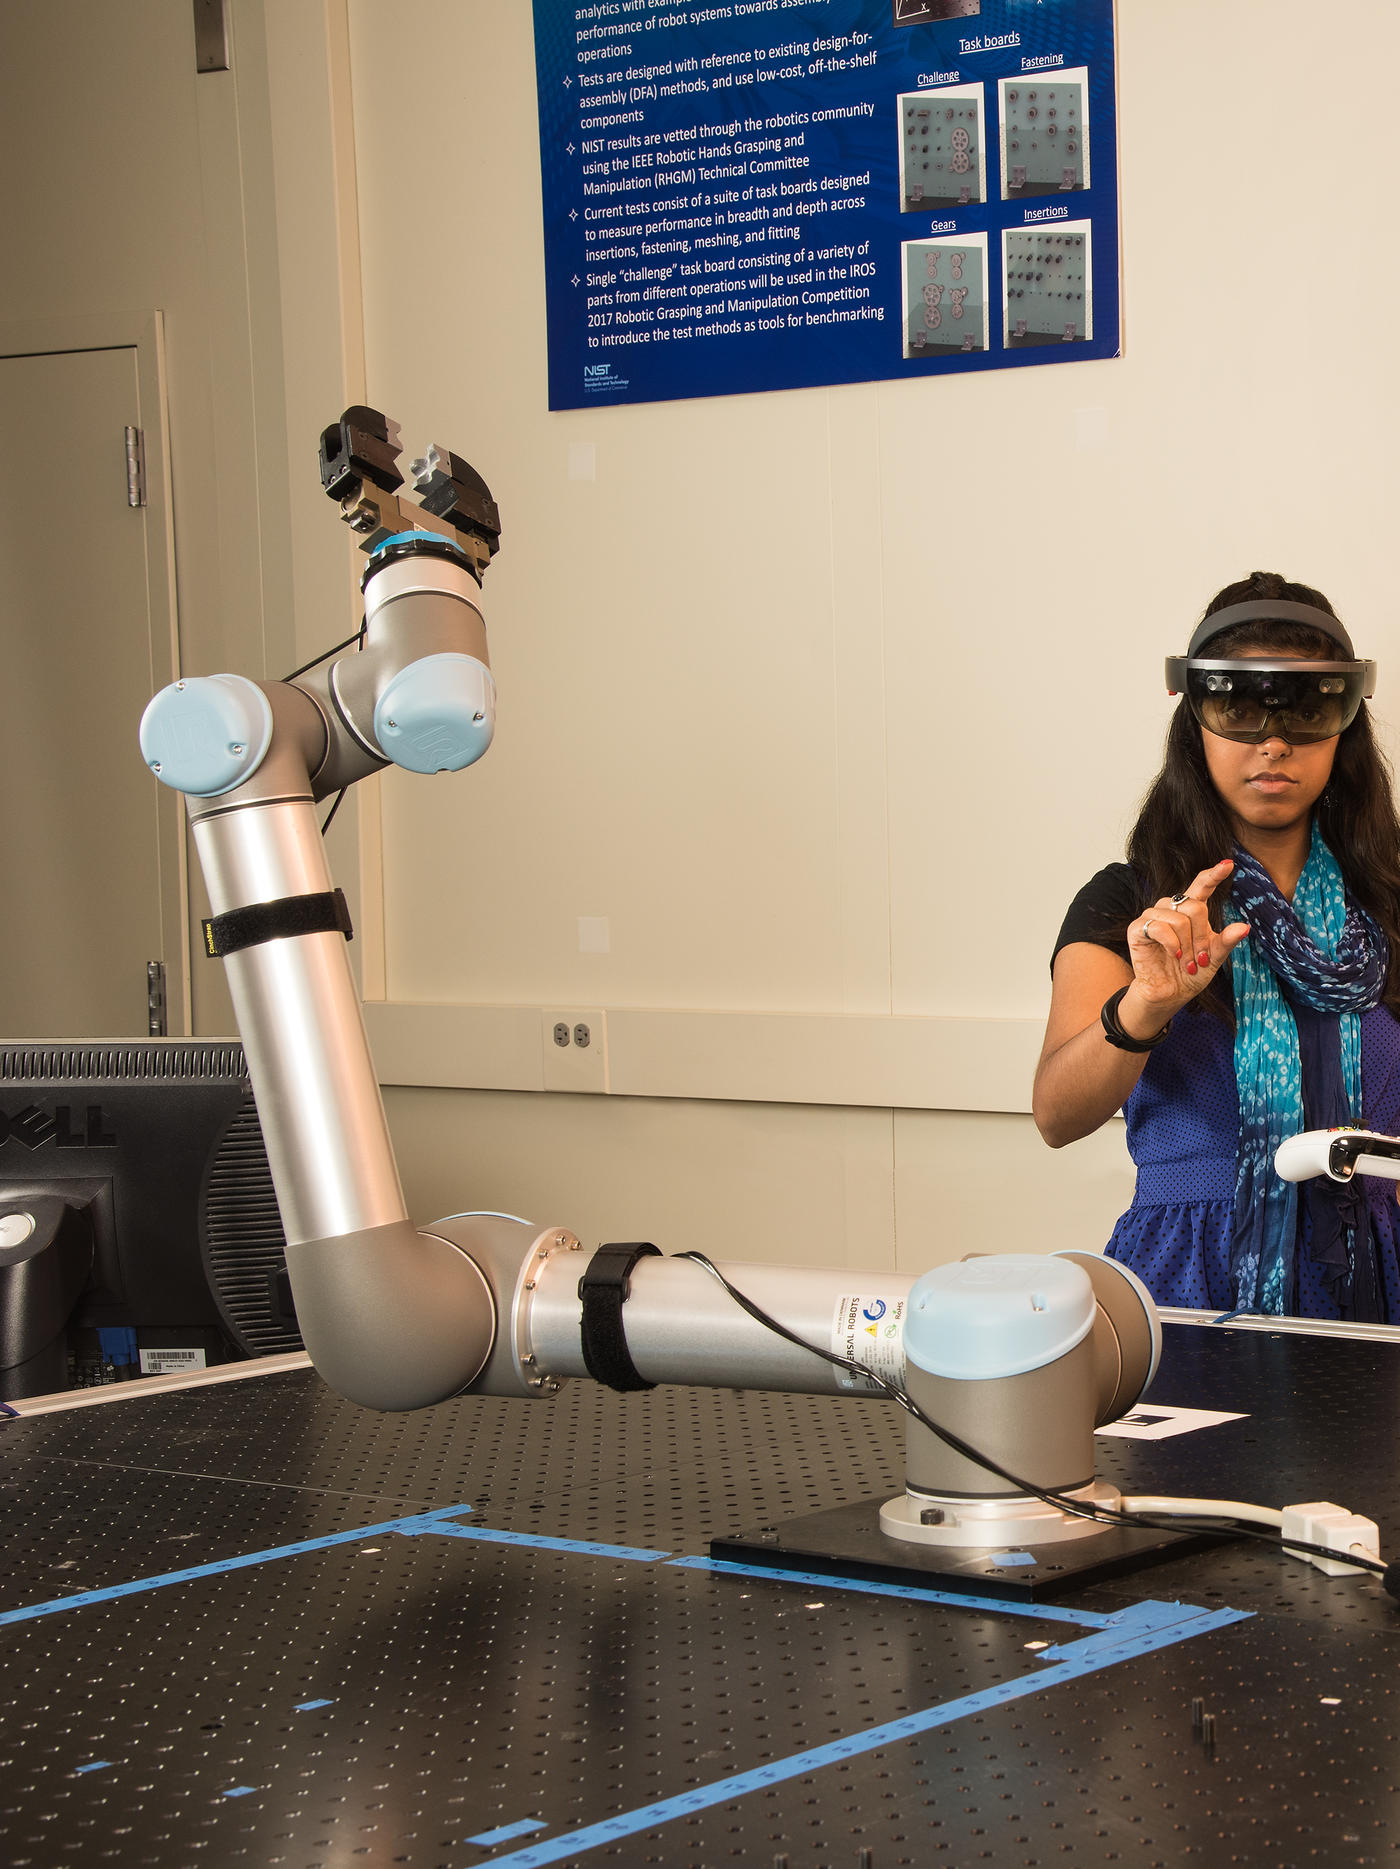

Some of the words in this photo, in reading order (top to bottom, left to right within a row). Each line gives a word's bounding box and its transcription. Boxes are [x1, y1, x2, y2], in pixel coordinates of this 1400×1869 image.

[578, 73, 604, 87] Tests
[606, 71, 623, 83] are
[625, 60, 672, 80] designed
[674, 56, 698, 72] with
[700, 51, 751, 69] reference
[754, 48, 766, 61] to
[768, 42, 810, 58] existing
[812, 31, 872, 52] design-for-
[959, 38, 982, 52] Task
[984, 30, 1020, 48] boards
[1021, 53, 1063, 68] Fastening
[579, 89, 627, 108] assembly
[629, 84, 657, 104] (DFA)
[660, 77, 709, 96] methods,
[712, 72, 732, 89] and
[735, 73, 754, 85] use
[756, 64, 805, 82] low-cost,
[808, 50, 877, 74] off-the-shelf
[918, 70, 960, 85] Challenge
[582, 138, 605, 154] NIST
[607, 134, 642, 150] results
[644, 134, 661, 146] are
[662, 125, 697, 143] vetted
[699, 119, 741, 138] through
[744, 117, 762, 132] the
[765, 112, 809, 128] robotics
[811, 102, 874, 122] community
[582, 160, 610, 175] using
[611, 157, 629, 171] the
[631, 153, 653, 168] IEEE
[656, 148, 696, 165] Robotic
[698, 142, 732, 159] Hands
[734, 138, 782, 154] Grasping
[784, 131, 804, 148] and
[584, 204, 623, 220] Current
[625, 201, 650, 215] tests
[652, 196, 688, 212] consist
[690, 192, 702, 207] of
[704, 194, 710, 206] a
[713, 189, 739, 204] suite
[741, 185, 753, 200] of
[755, 183, 778, 199] task
[780, 178, 818, 196] boards
[820, 170, 870, 191] designed
[1024, 205, 1068, 220] Insertions
[584, 229, 596, 241] to
[598, 224, 642, 239] measure
[645, 216, 712, 236] performance
[714, 212, 724, 225] in
[727, 205, 769, 224] breadth
[772, 202, 792, 218] and
[795, 198, 828, 216] depth
[830, 196, 865, 211] across
[931, 219, 956, 231] Gears
[586, 271, 616, 288] Single
[680, 260, 702, 276] task
[704, 256, 735, 273] board
[737, 251, 791, 269] consisting
[793, 247, 805, 263] of
[807, 250, 814, 261] a
[816, 244, 855, 260] variety
[857, 240, 869, 255] of
[587, 293, 613, 310] parts
[615, 290, 640, 303] from
[642, 284, 687, 301] different
[689, 279, 746, 298] operations
[748, 273, 767, 289] will
[770, 273, 784, 287] be
[786, 268, 812, 285] used
[815, 270, 825, 281] in
[827, 265, 847, 280] the
[849, 262, 876, 277] IROS
[587, 312, 613, 327] 2017
[615, 308, 654, 324] Robotic
[656, 304, 702, 320] Grasping
[704, 300, 724, 315] and
[727, 293, 799, 312] Manipulation
[801, 285, 869, 304] Competition
[587, 336, 599, 348] to
[601, 330, 650, 346] introduce
[652, 327, 670, 341] the
[672, 326, 692, 339] test
[695, 319, 741, 336] methods
[744, 321, 756, 332] as
[757, 314, 785, 330] tools
[786, 313, 803, 327] for
[805, 305, 884, 325] benchmarking
[584, 364, 611, 377] NIST
[848, 1297, 860, 1330] ROBOTS
